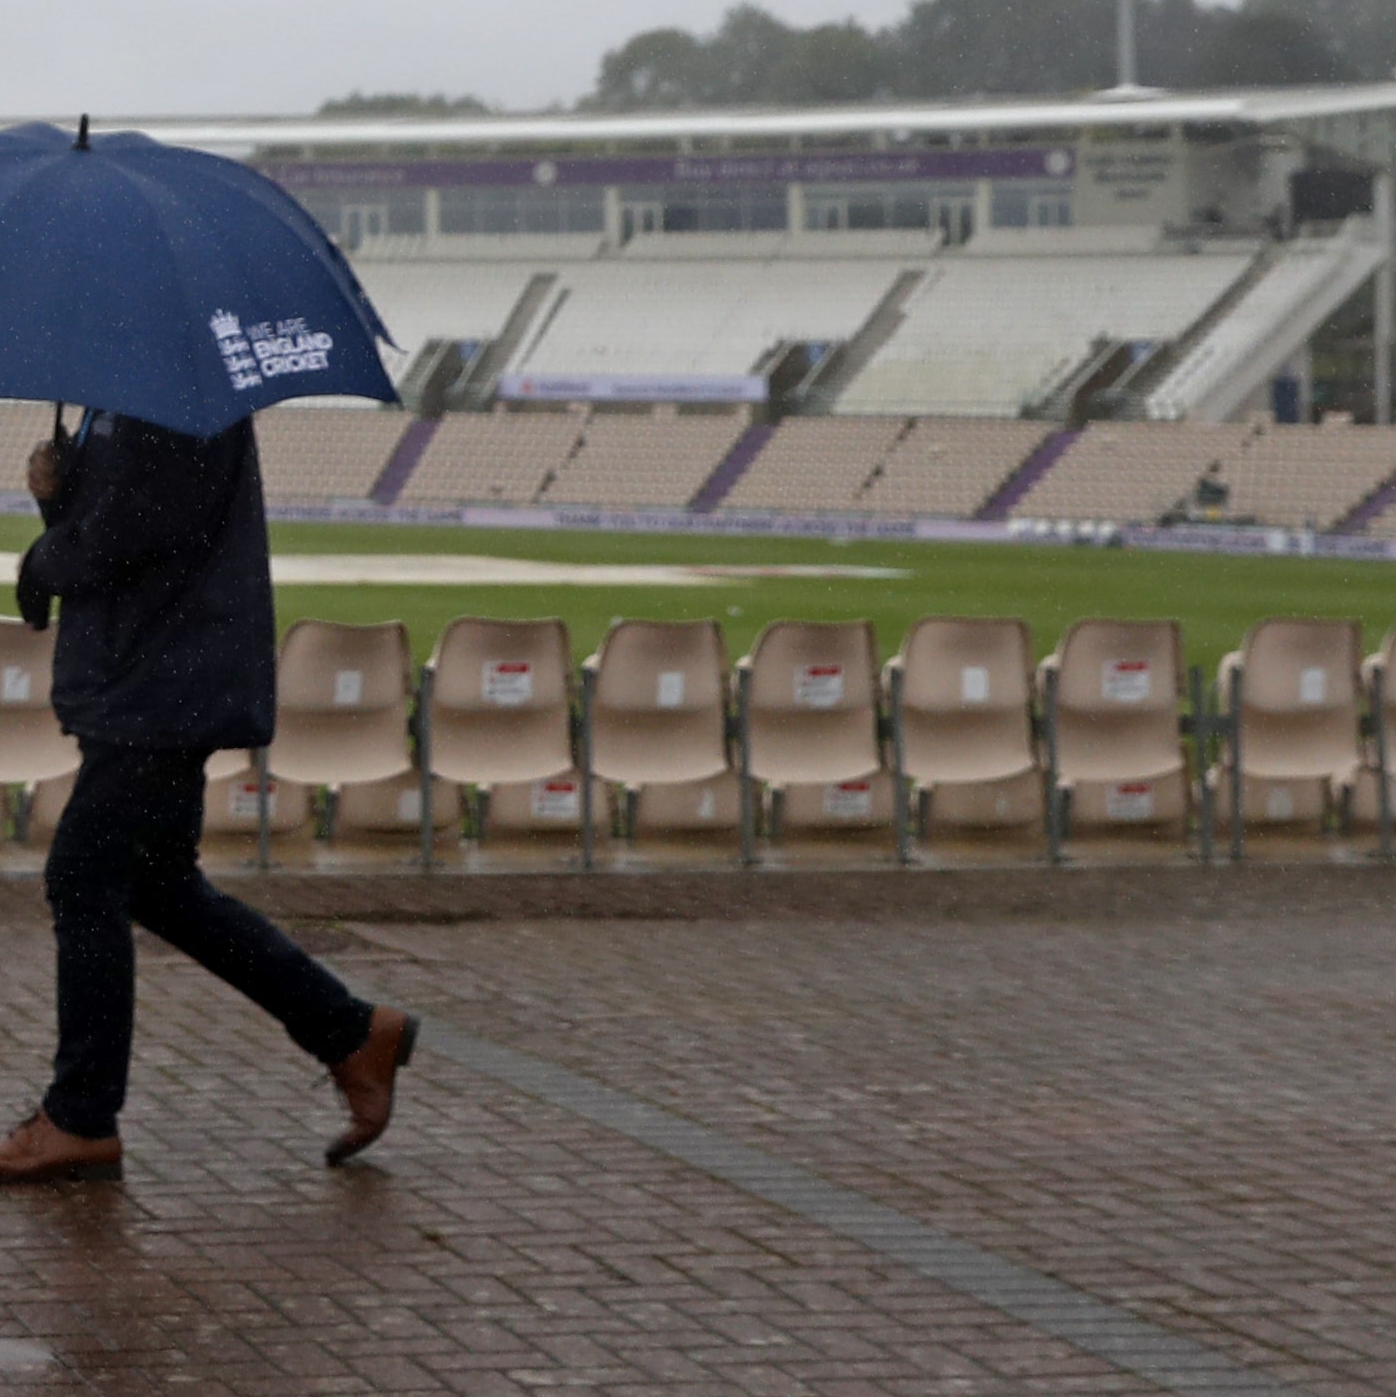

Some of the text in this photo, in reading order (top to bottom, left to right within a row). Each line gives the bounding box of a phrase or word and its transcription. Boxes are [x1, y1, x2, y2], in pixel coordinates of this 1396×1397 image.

[246, 317, 310, 340] WE ARE
[252, 332, 333, 360] ENGLAND
[260, 350, 329, 378] CRICKET
